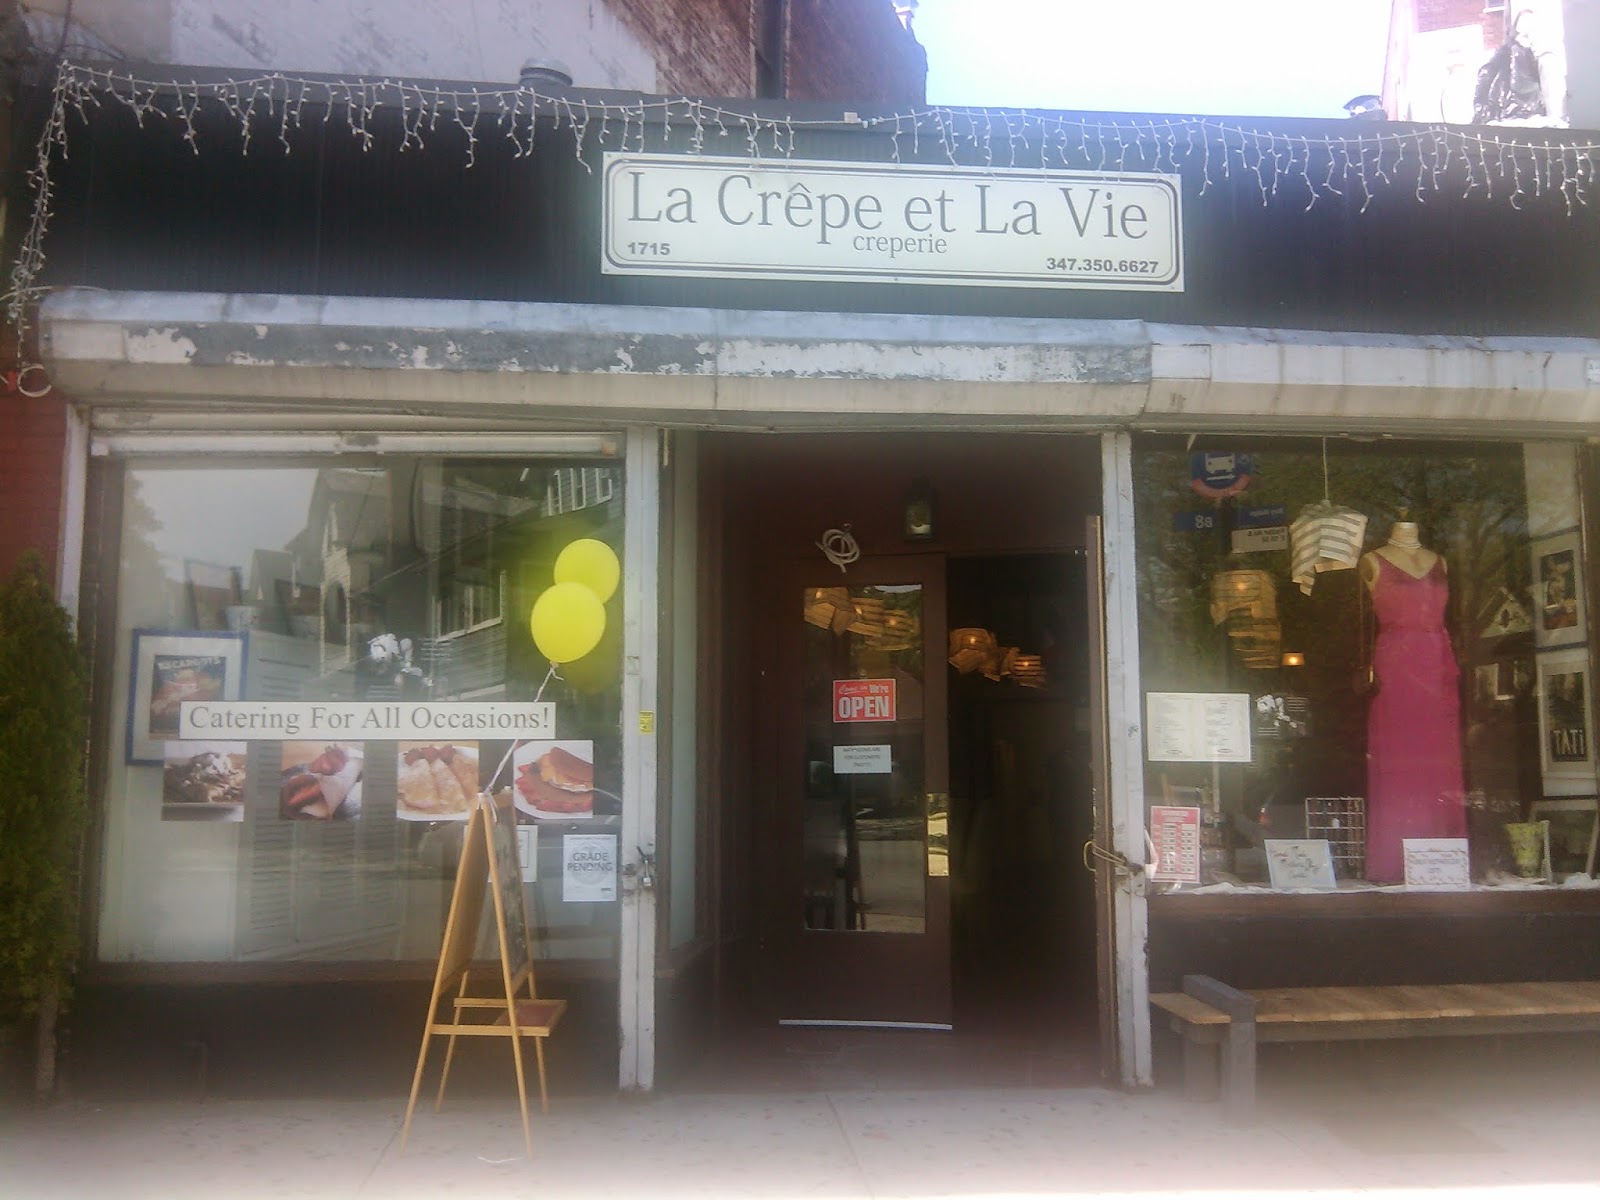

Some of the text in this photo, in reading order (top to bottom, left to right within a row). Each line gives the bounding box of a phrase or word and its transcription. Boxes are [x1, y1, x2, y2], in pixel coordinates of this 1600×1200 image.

[628, 171, 1148, 245] La Crêpe et La Vie
[627, 242, 671, 256] 1715
[853, 233, 948, 259] creperie
[1046, 257, 1159, 274] 347.350.6627
[838, 696, 889, 719] OPEN
[189, 706, 549, 735] Catering For All Occasions!
[567, 862, 613, 872] PENDING
[573, 852, 608, 862] GRADE
